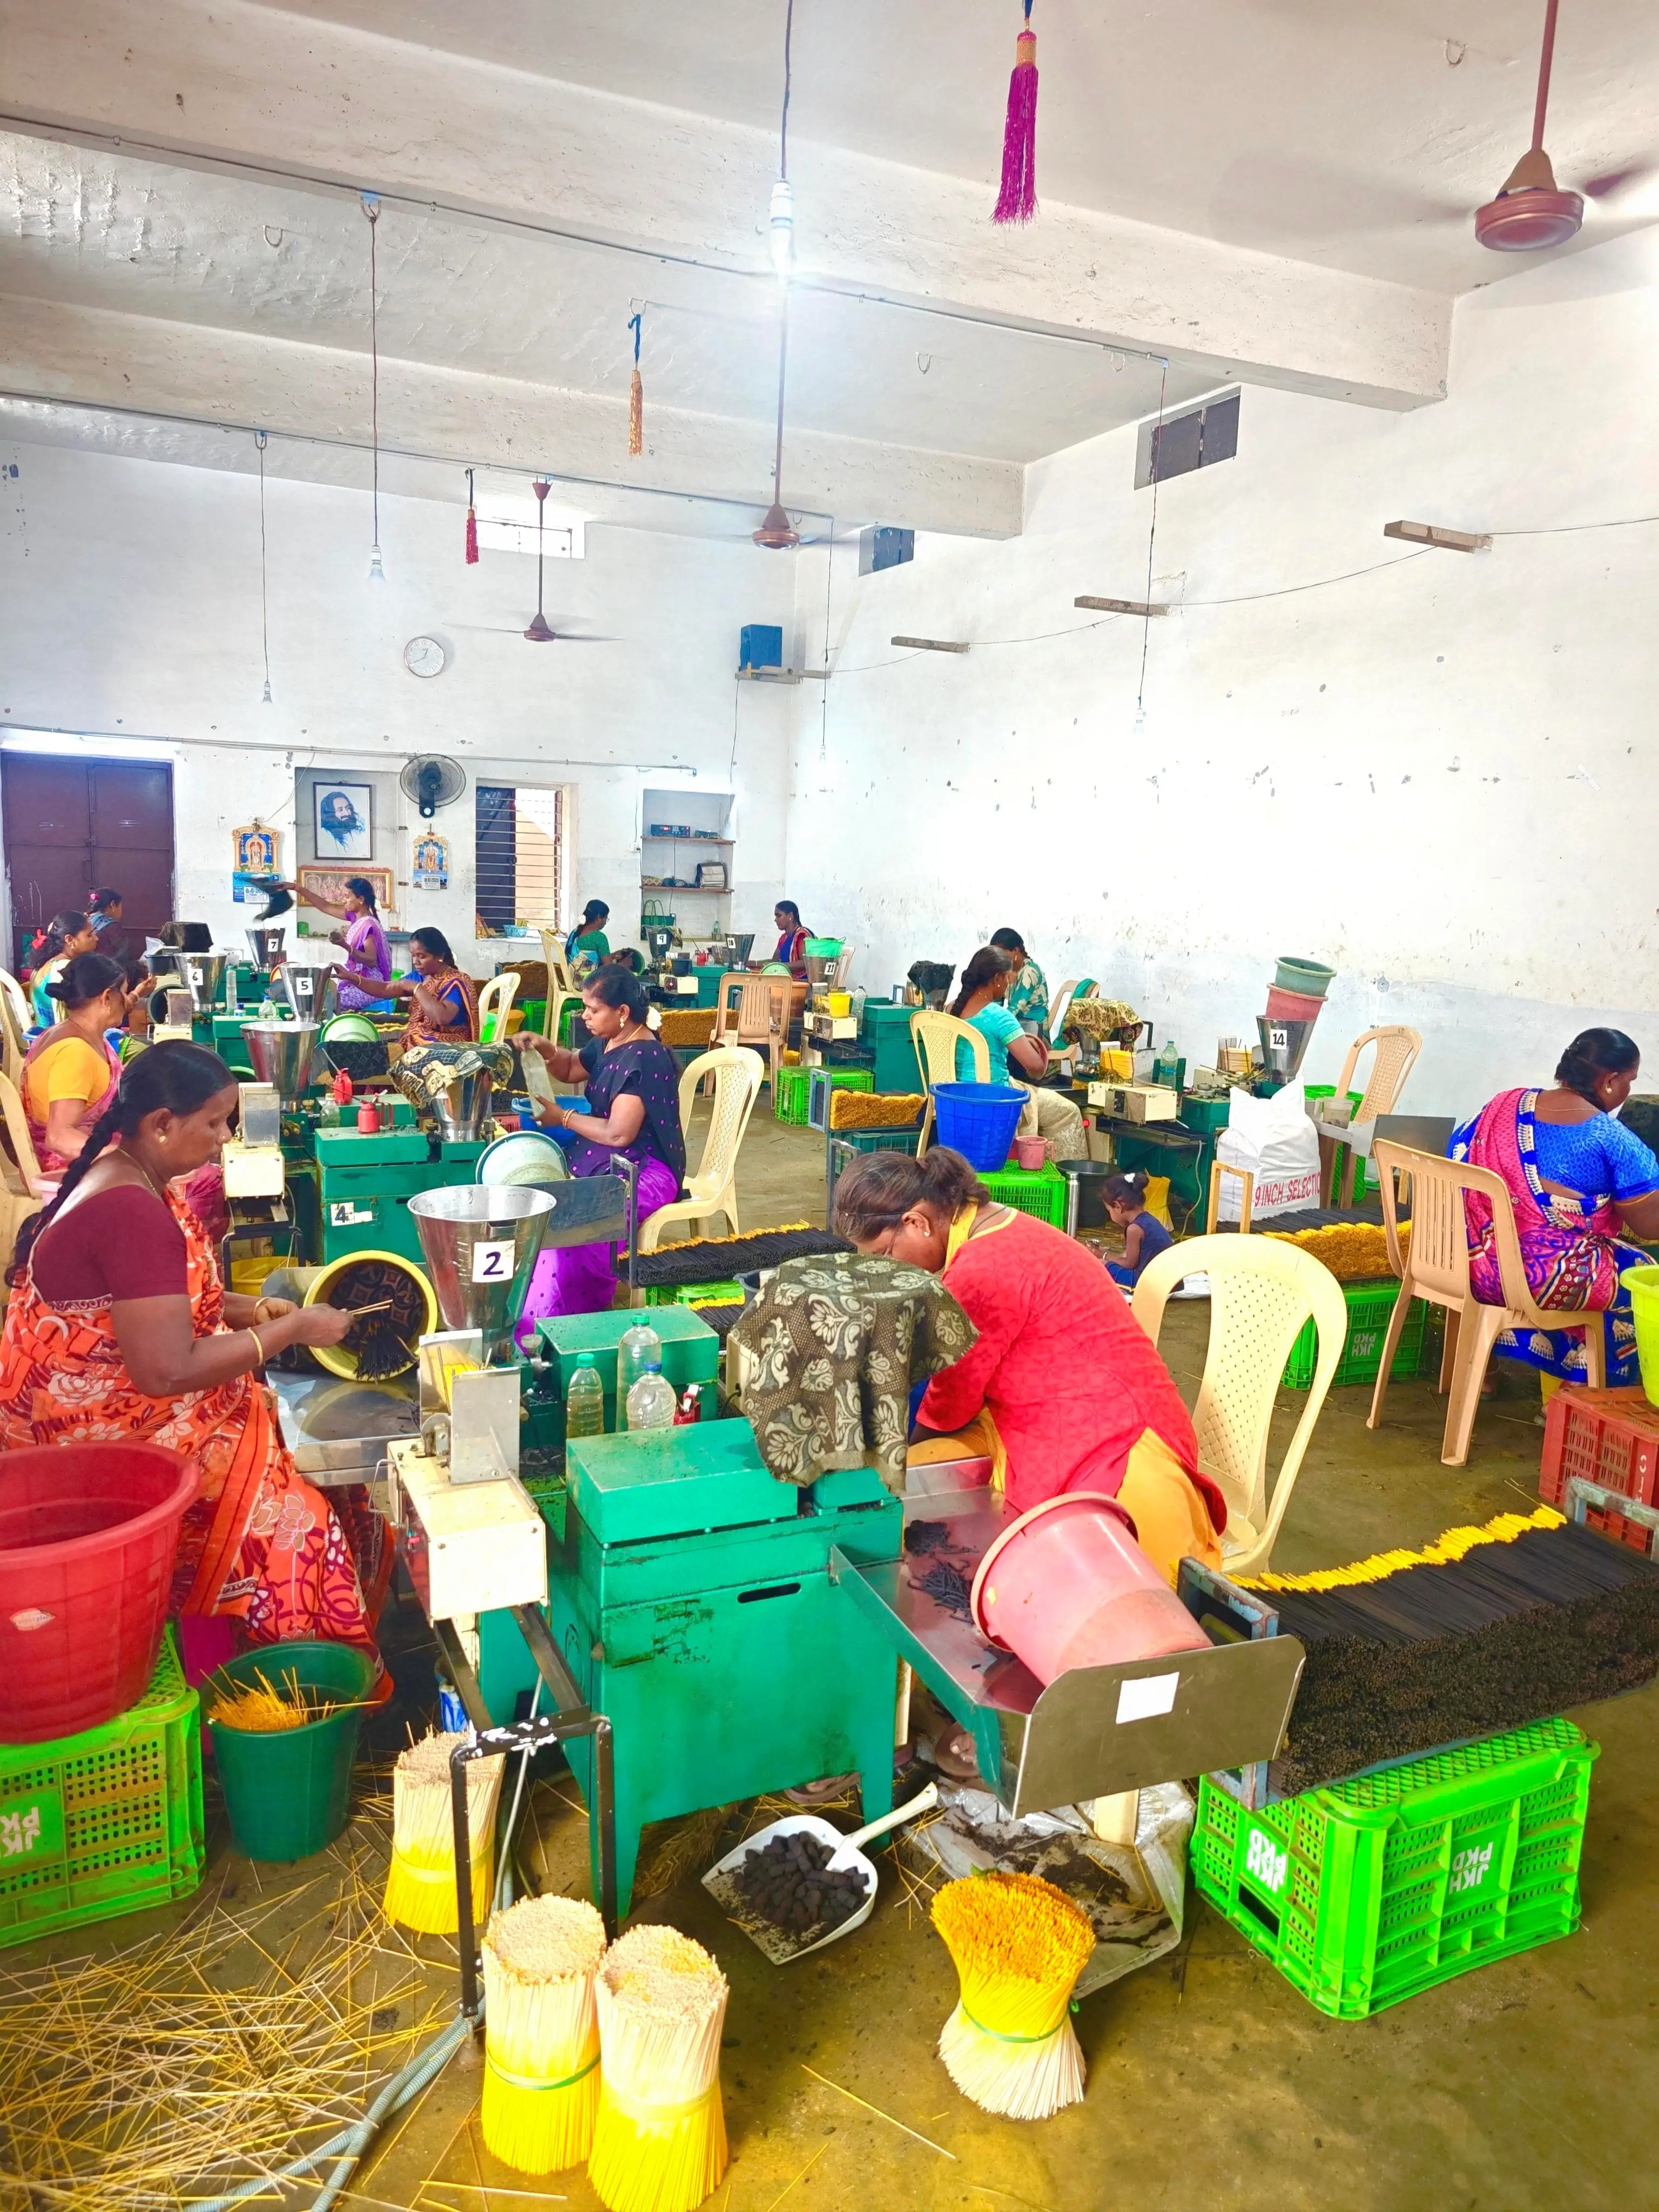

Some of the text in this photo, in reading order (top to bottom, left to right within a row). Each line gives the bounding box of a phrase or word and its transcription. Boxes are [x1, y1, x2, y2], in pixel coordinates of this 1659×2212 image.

[659, 935, 664, 943] 9
[192, 972, 198, 981] 6
[827, 964, 835, 973] 11
[301, 981, 309, 990] 5
[1273, 1033, 1285, 1046] 14
[335, 1205, 349, 1223] 4
[483, 1251, 504, 1276] 2
[1249, 1828, 1287, 1876] PKD
[1452, 1841, 1493, 1872] PKD
[1246, 1848, 1284, 1893] JKH
[1448, 1863, 1489, 1895] JKH
